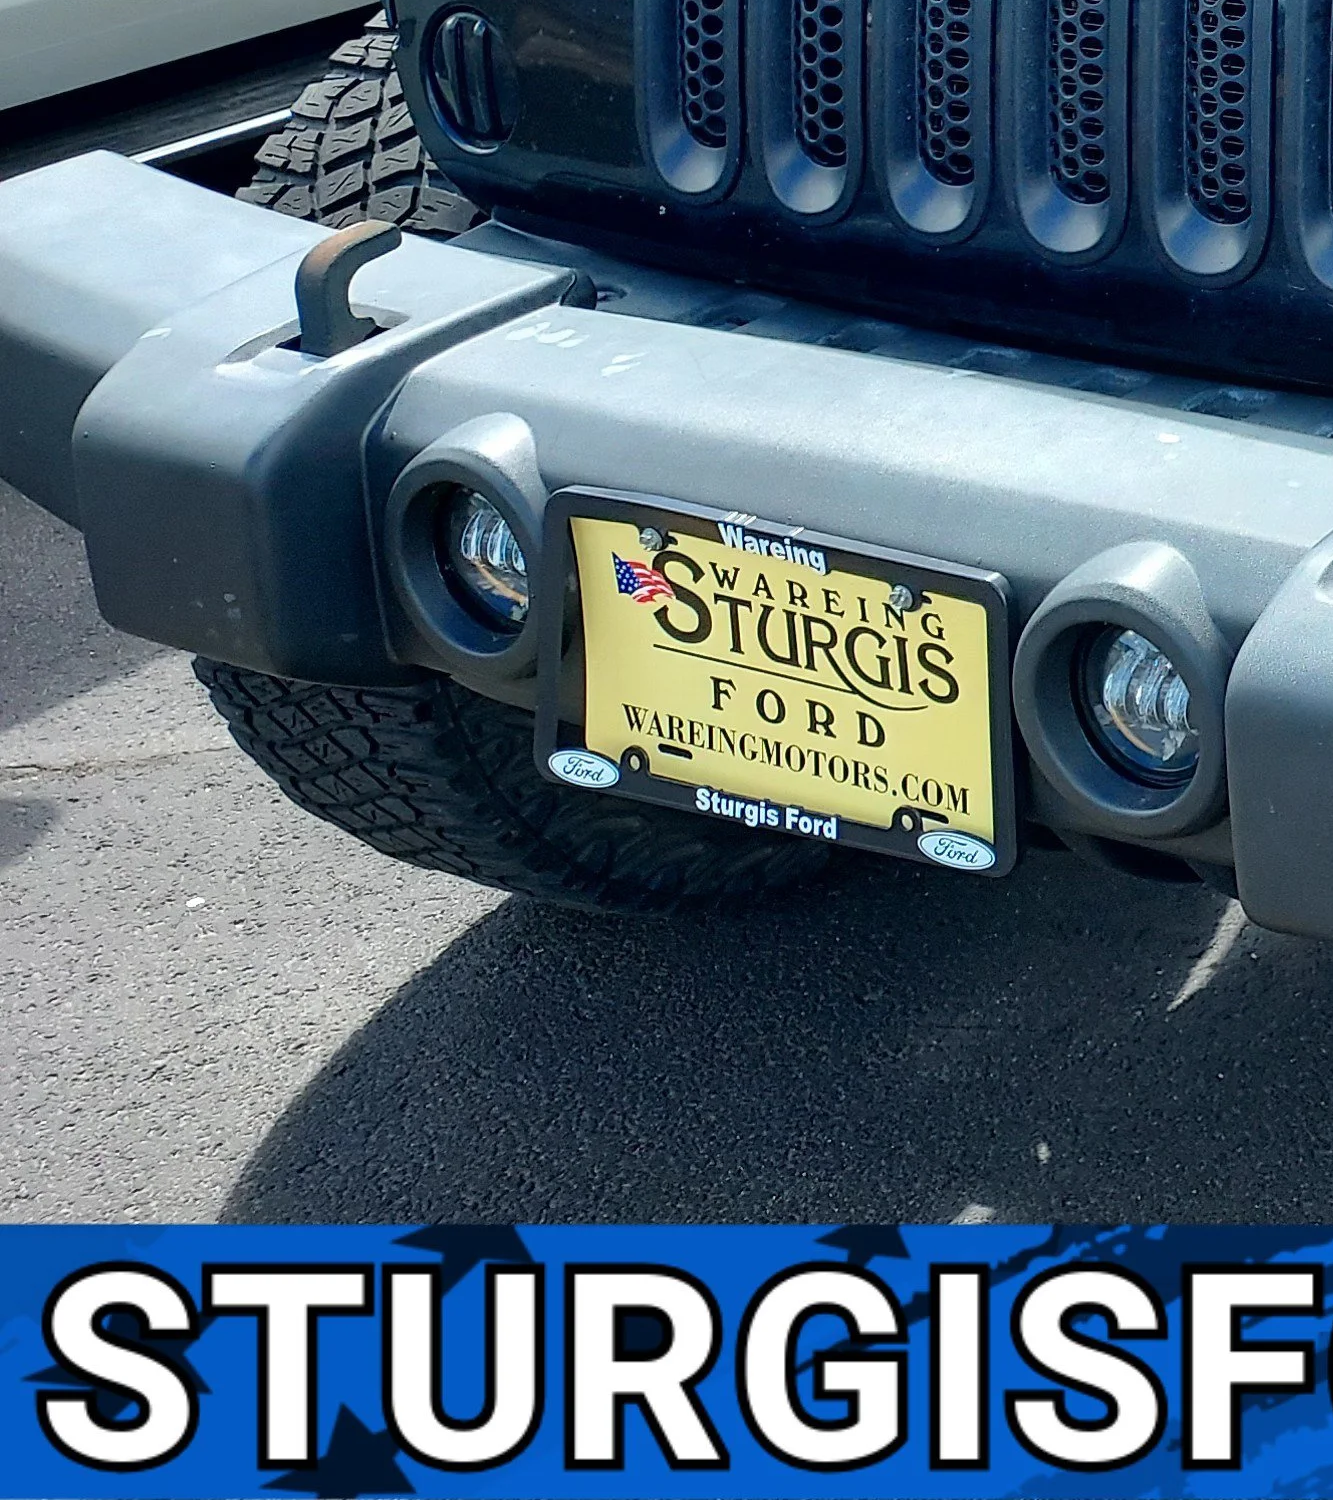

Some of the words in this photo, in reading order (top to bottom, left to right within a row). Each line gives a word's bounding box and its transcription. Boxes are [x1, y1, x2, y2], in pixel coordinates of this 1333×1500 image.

[718, 522, 828, 574] Wareing
[652, 550, 960, 711] STURGIS
[709, 562, 946, 641] WAREING
[710, 676, 887, 748] FORD
[562, 754, 606, 784] Ford
[622, 703, 971, 816] WAREINGMOTORS.COM
[695, 787, 779, 829] Sturgis
[785, 806, 839, 841] Ford
[932, 836, 979, 865] Ford
